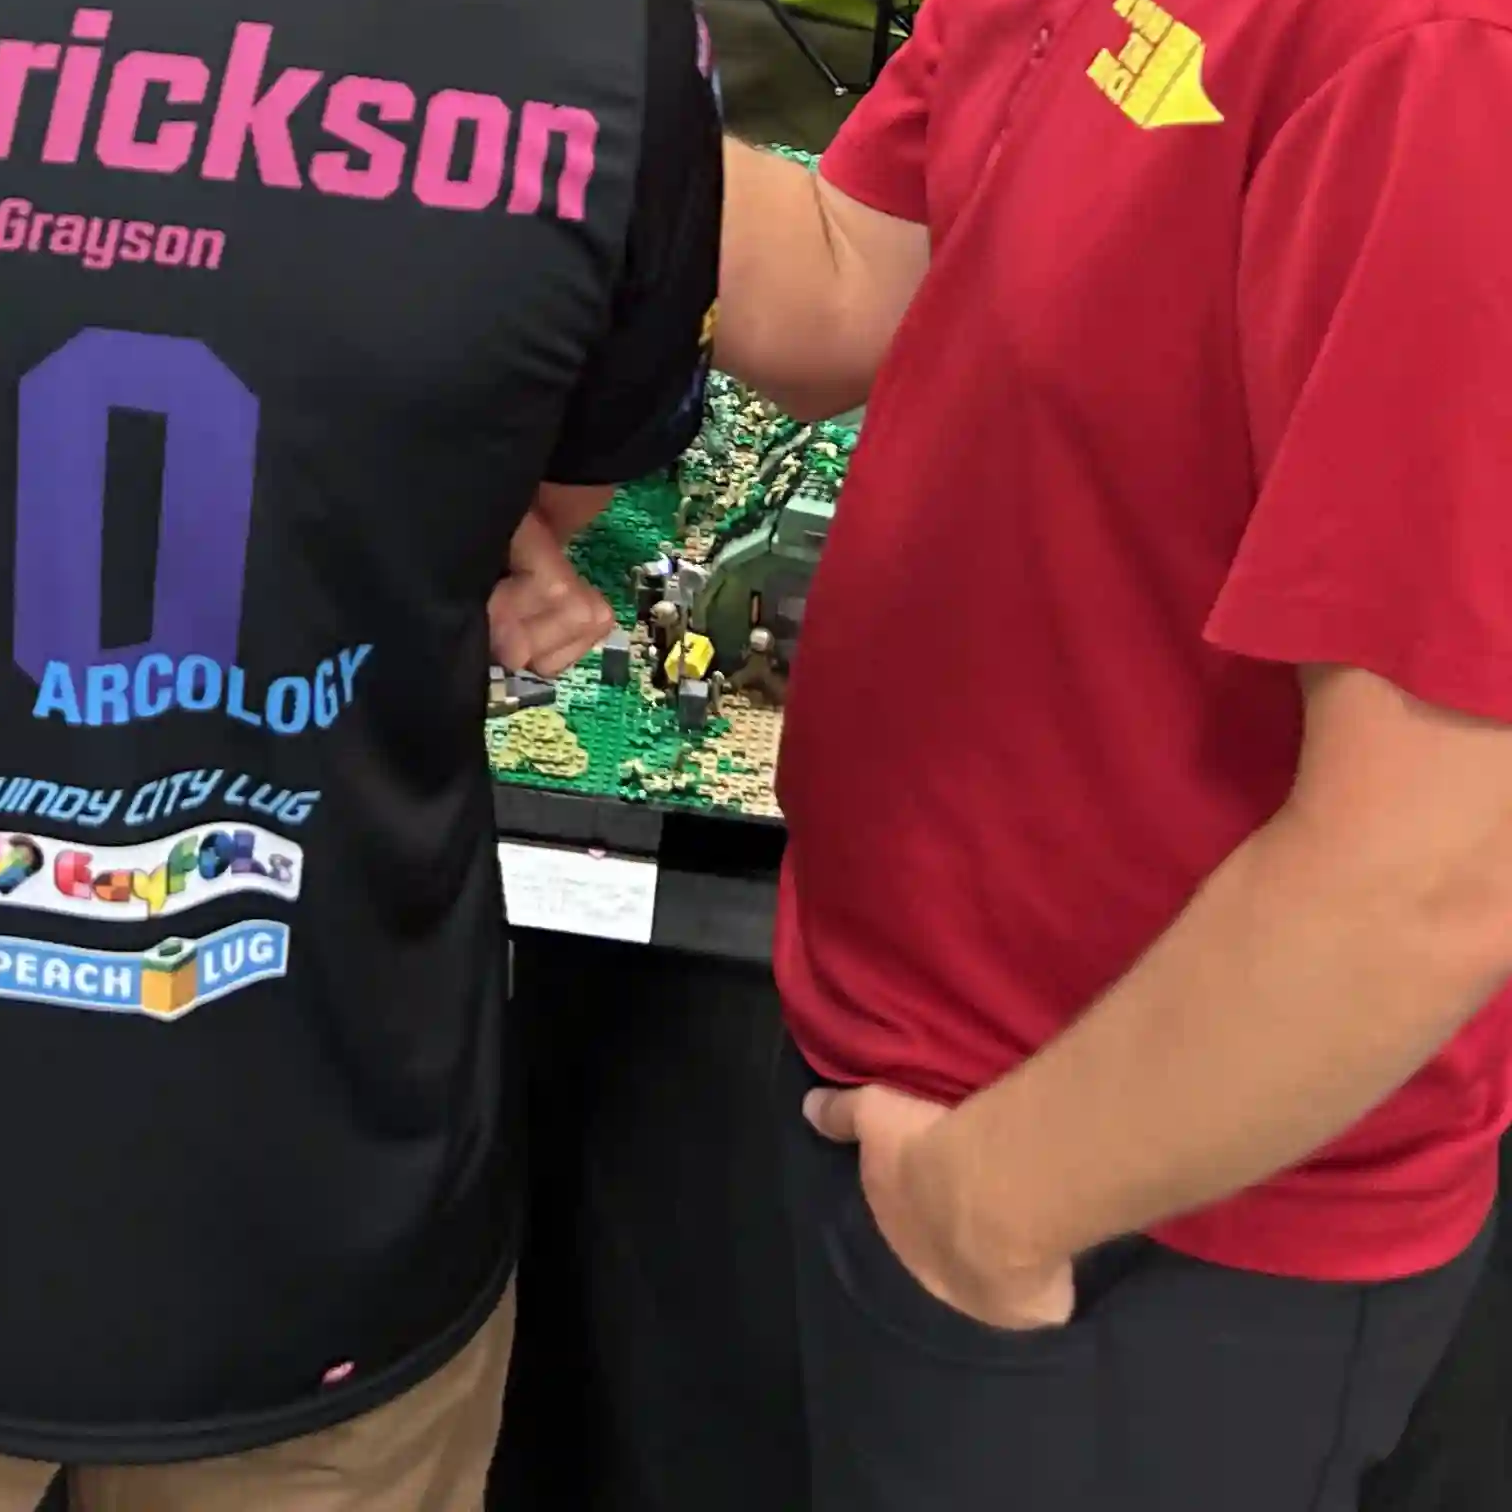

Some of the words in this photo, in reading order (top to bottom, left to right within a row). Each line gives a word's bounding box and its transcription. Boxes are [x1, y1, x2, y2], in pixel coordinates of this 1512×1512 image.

[32, 644, 373, 735] ARCOLOGY
[123, 768, 224, 826] CITY
[224, 773, 322, 825] LUG
[201, 932, 275, 983] LUG
